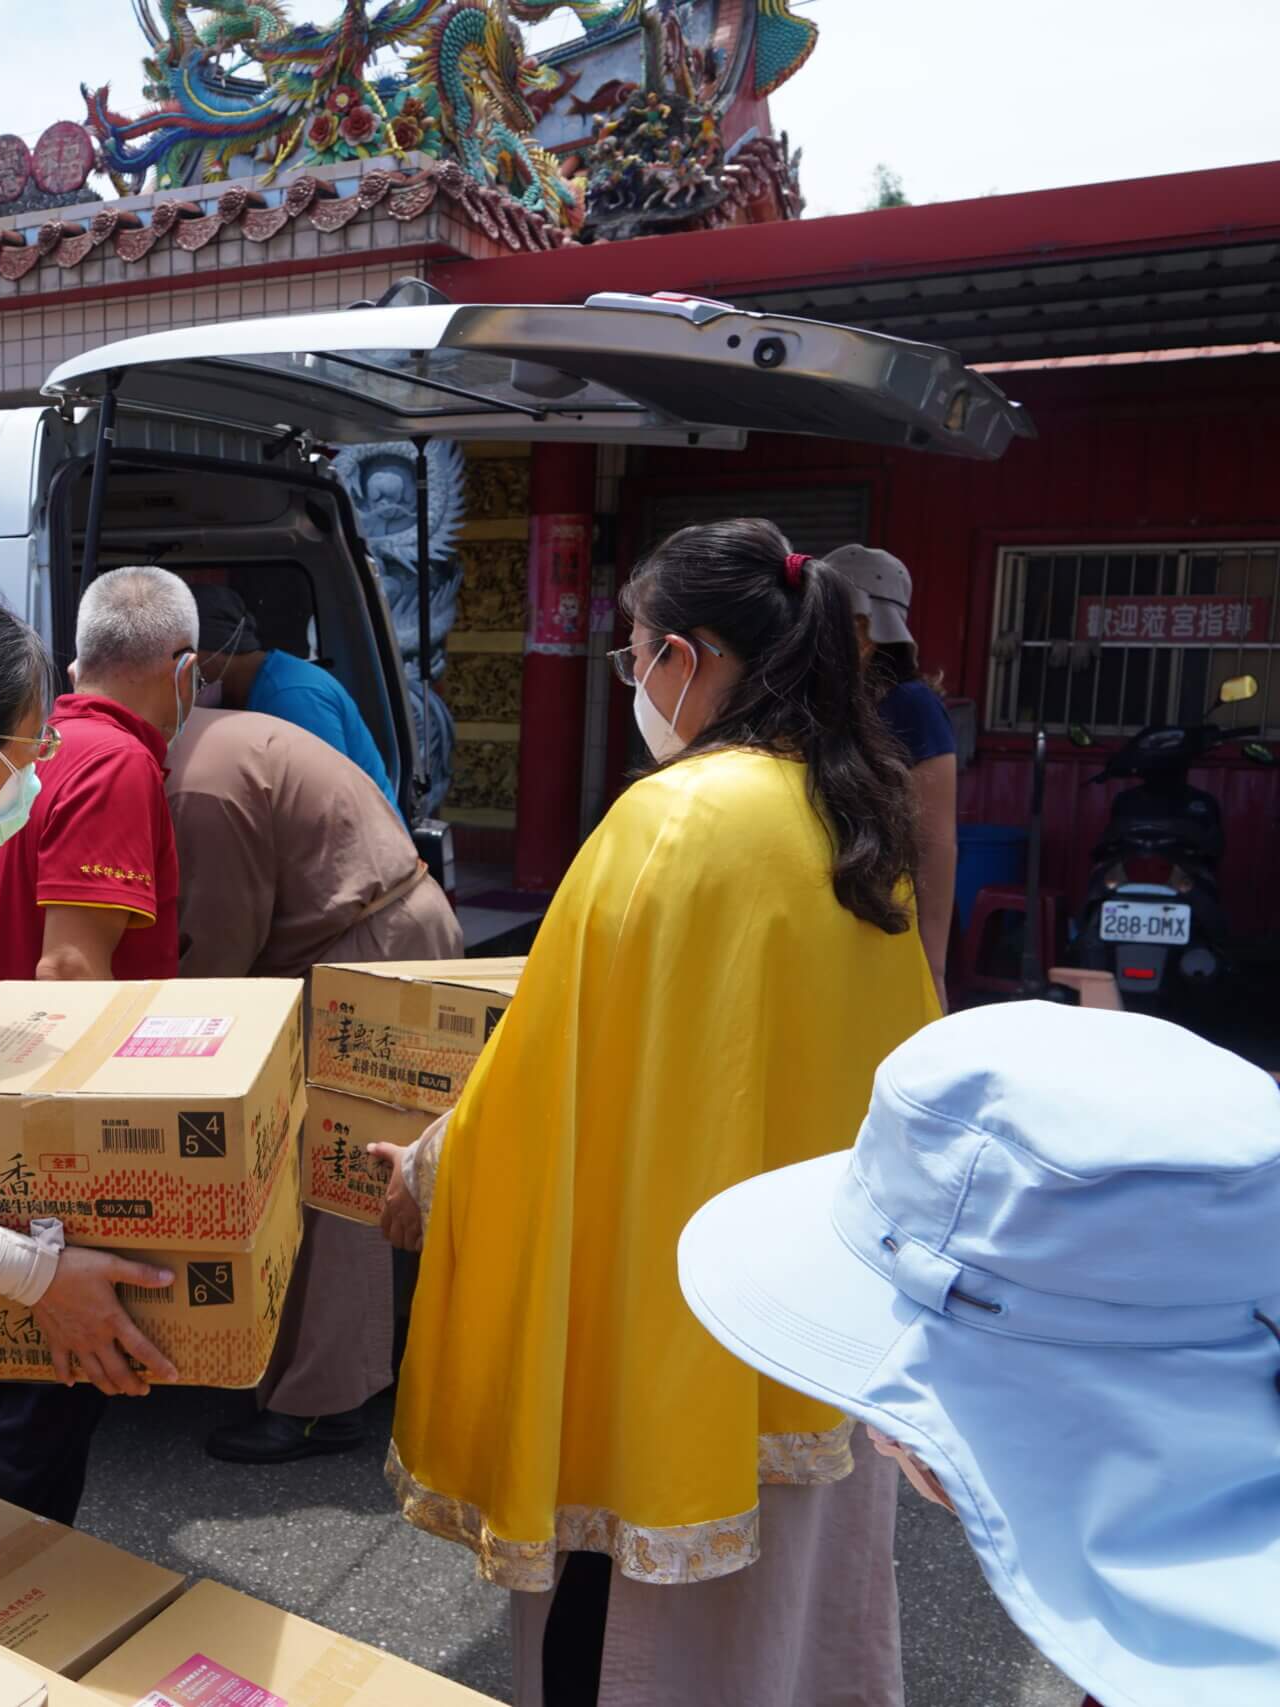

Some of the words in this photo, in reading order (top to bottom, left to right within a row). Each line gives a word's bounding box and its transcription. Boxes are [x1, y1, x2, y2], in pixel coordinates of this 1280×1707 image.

[1104, 915, 1186, 937] 288-DMX
[206, 1115, 220, 1135] 4
[185, 1135, 199, 1154] 5
[52, 1157, 76, 1169] 全素
[215, 1265, 228, 1284] 5
[194, 1284, 208, 1303] 6
